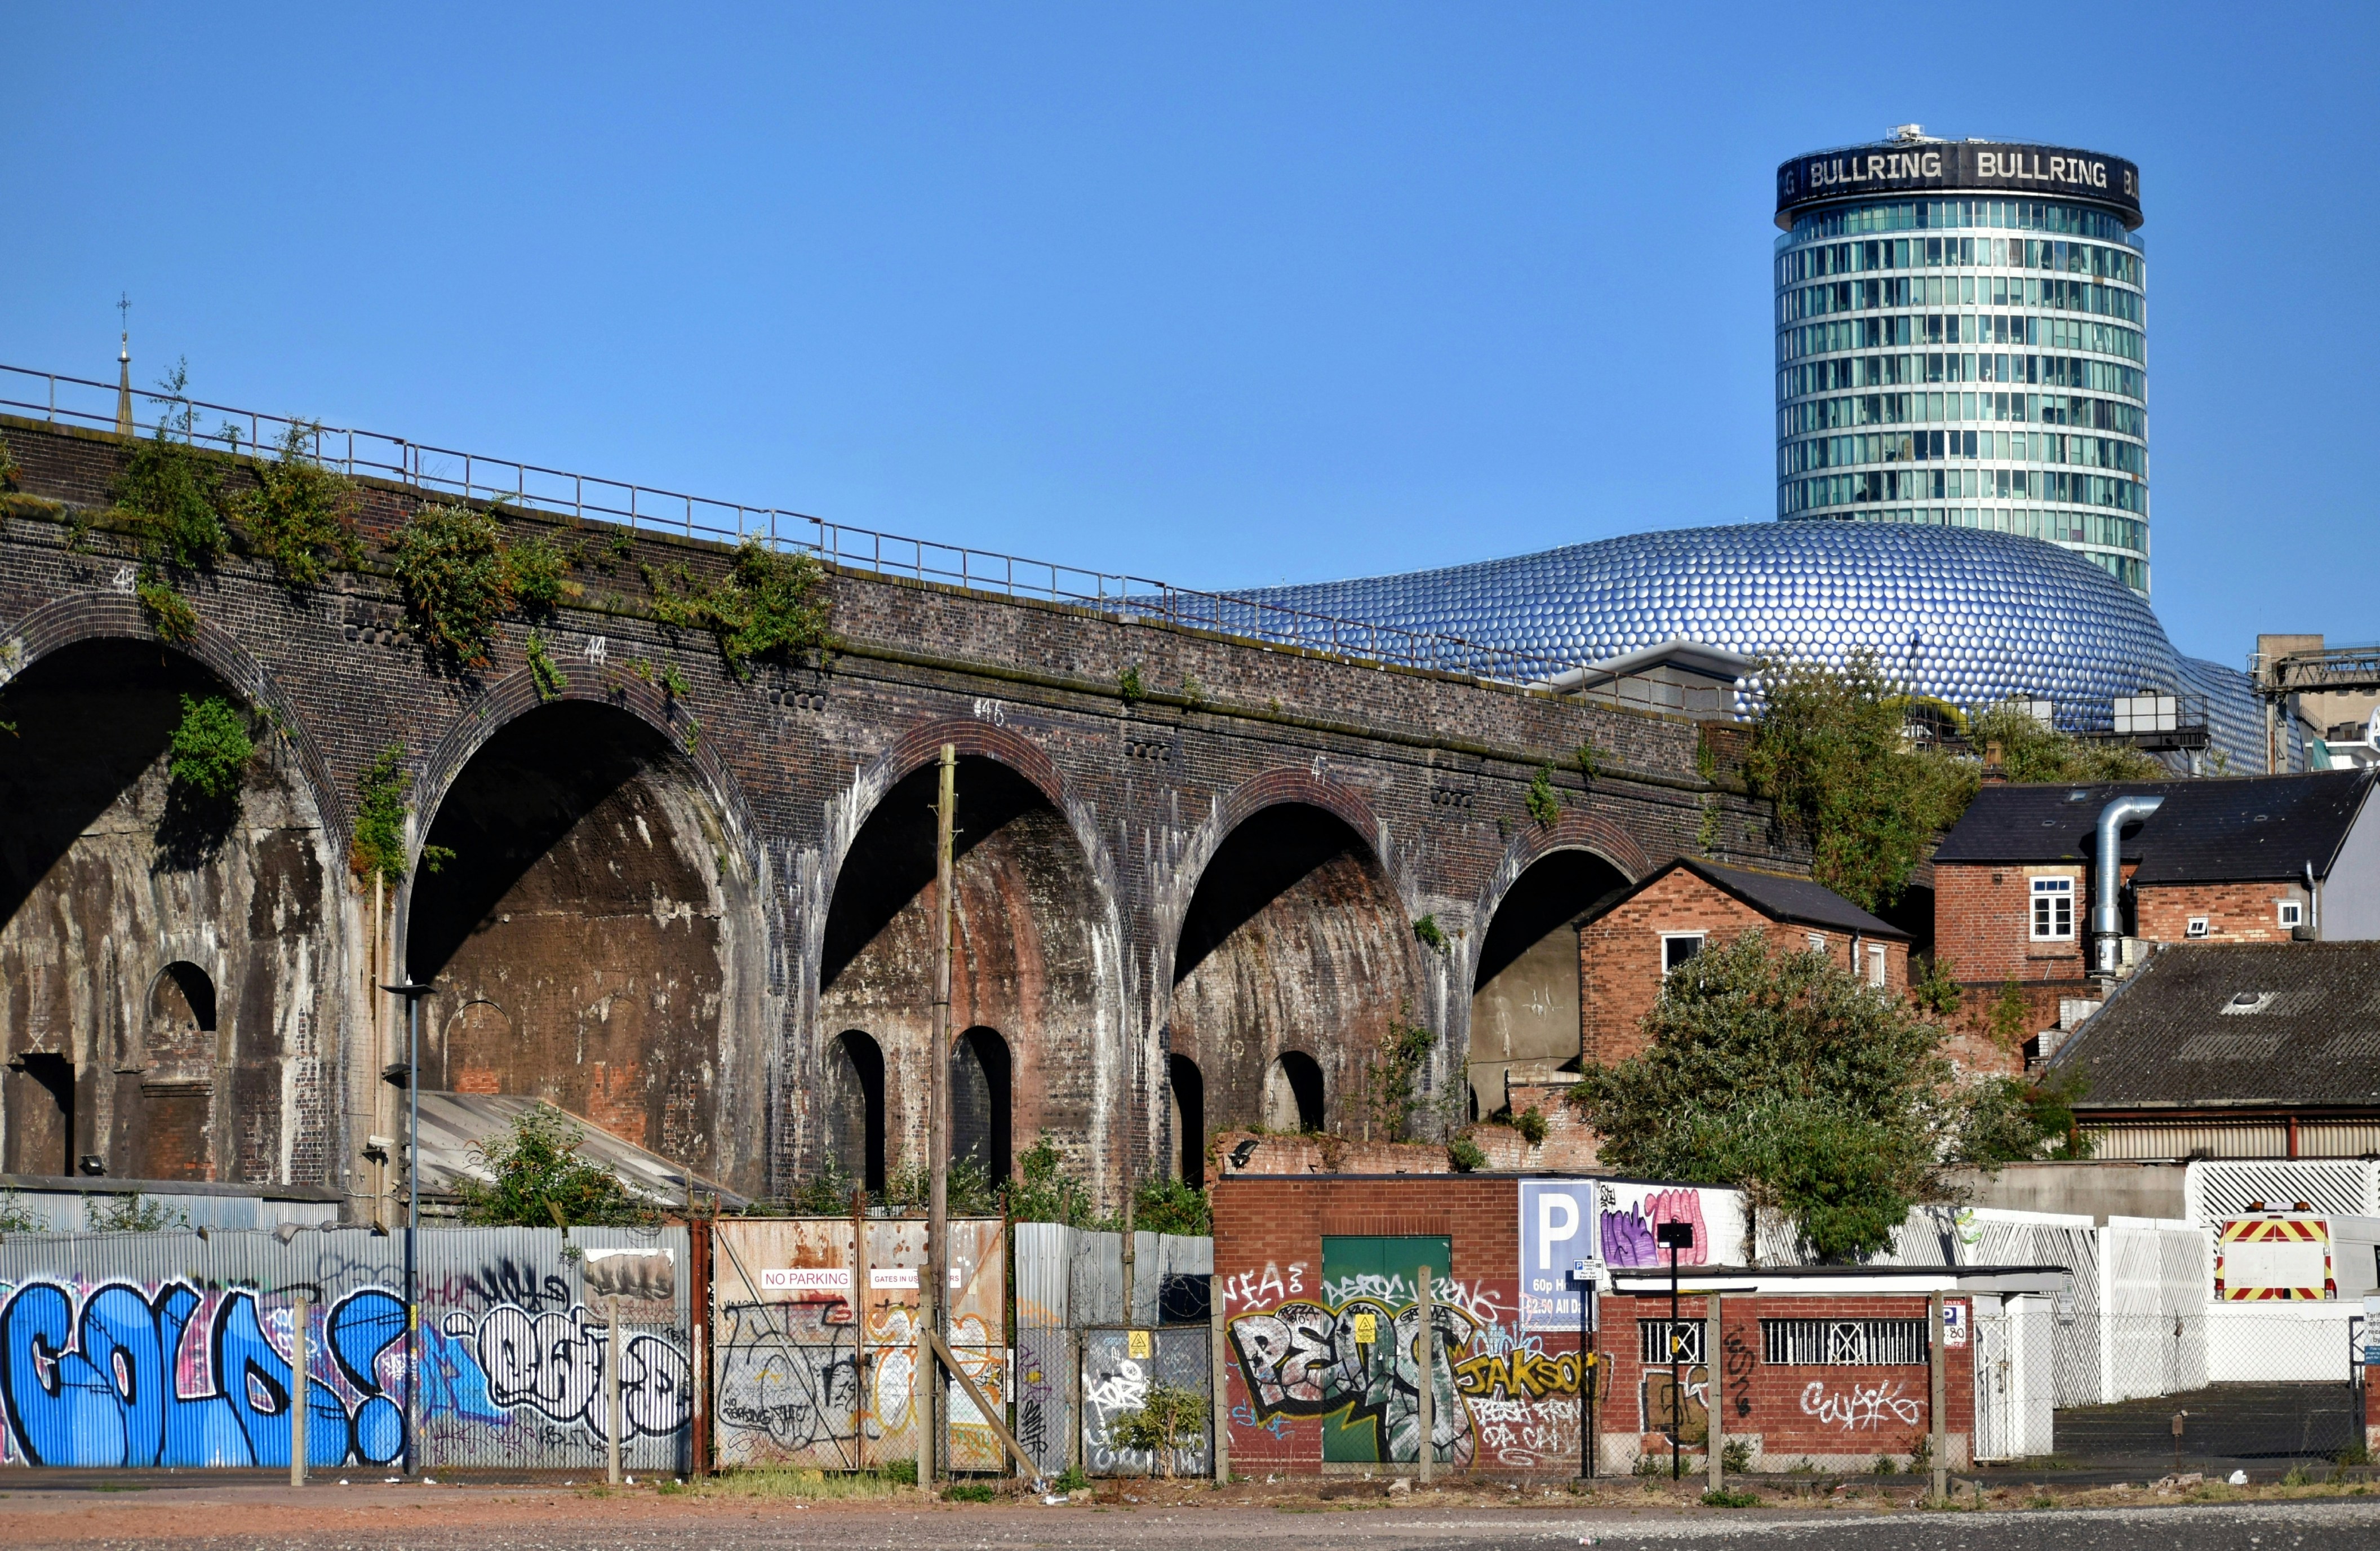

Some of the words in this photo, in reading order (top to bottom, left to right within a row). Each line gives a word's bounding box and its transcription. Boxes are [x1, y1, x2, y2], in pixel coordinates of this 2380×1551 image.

[1810, 152, 1942, 188] BULLRING
[1978, 152, 2107, 188] BULLRING
[585, 635, 607, 665] 44
[1539, 1193, 1579, 1270] P
[766, 1273, 785, 1285] NO
[789, 1273, 848, 1285] PARKING
[1533, 1278, 1552, 1294] 60p
[1556, 1279, 1582, 1292] Hour
[1556, 1298, 1569, 1314] All
